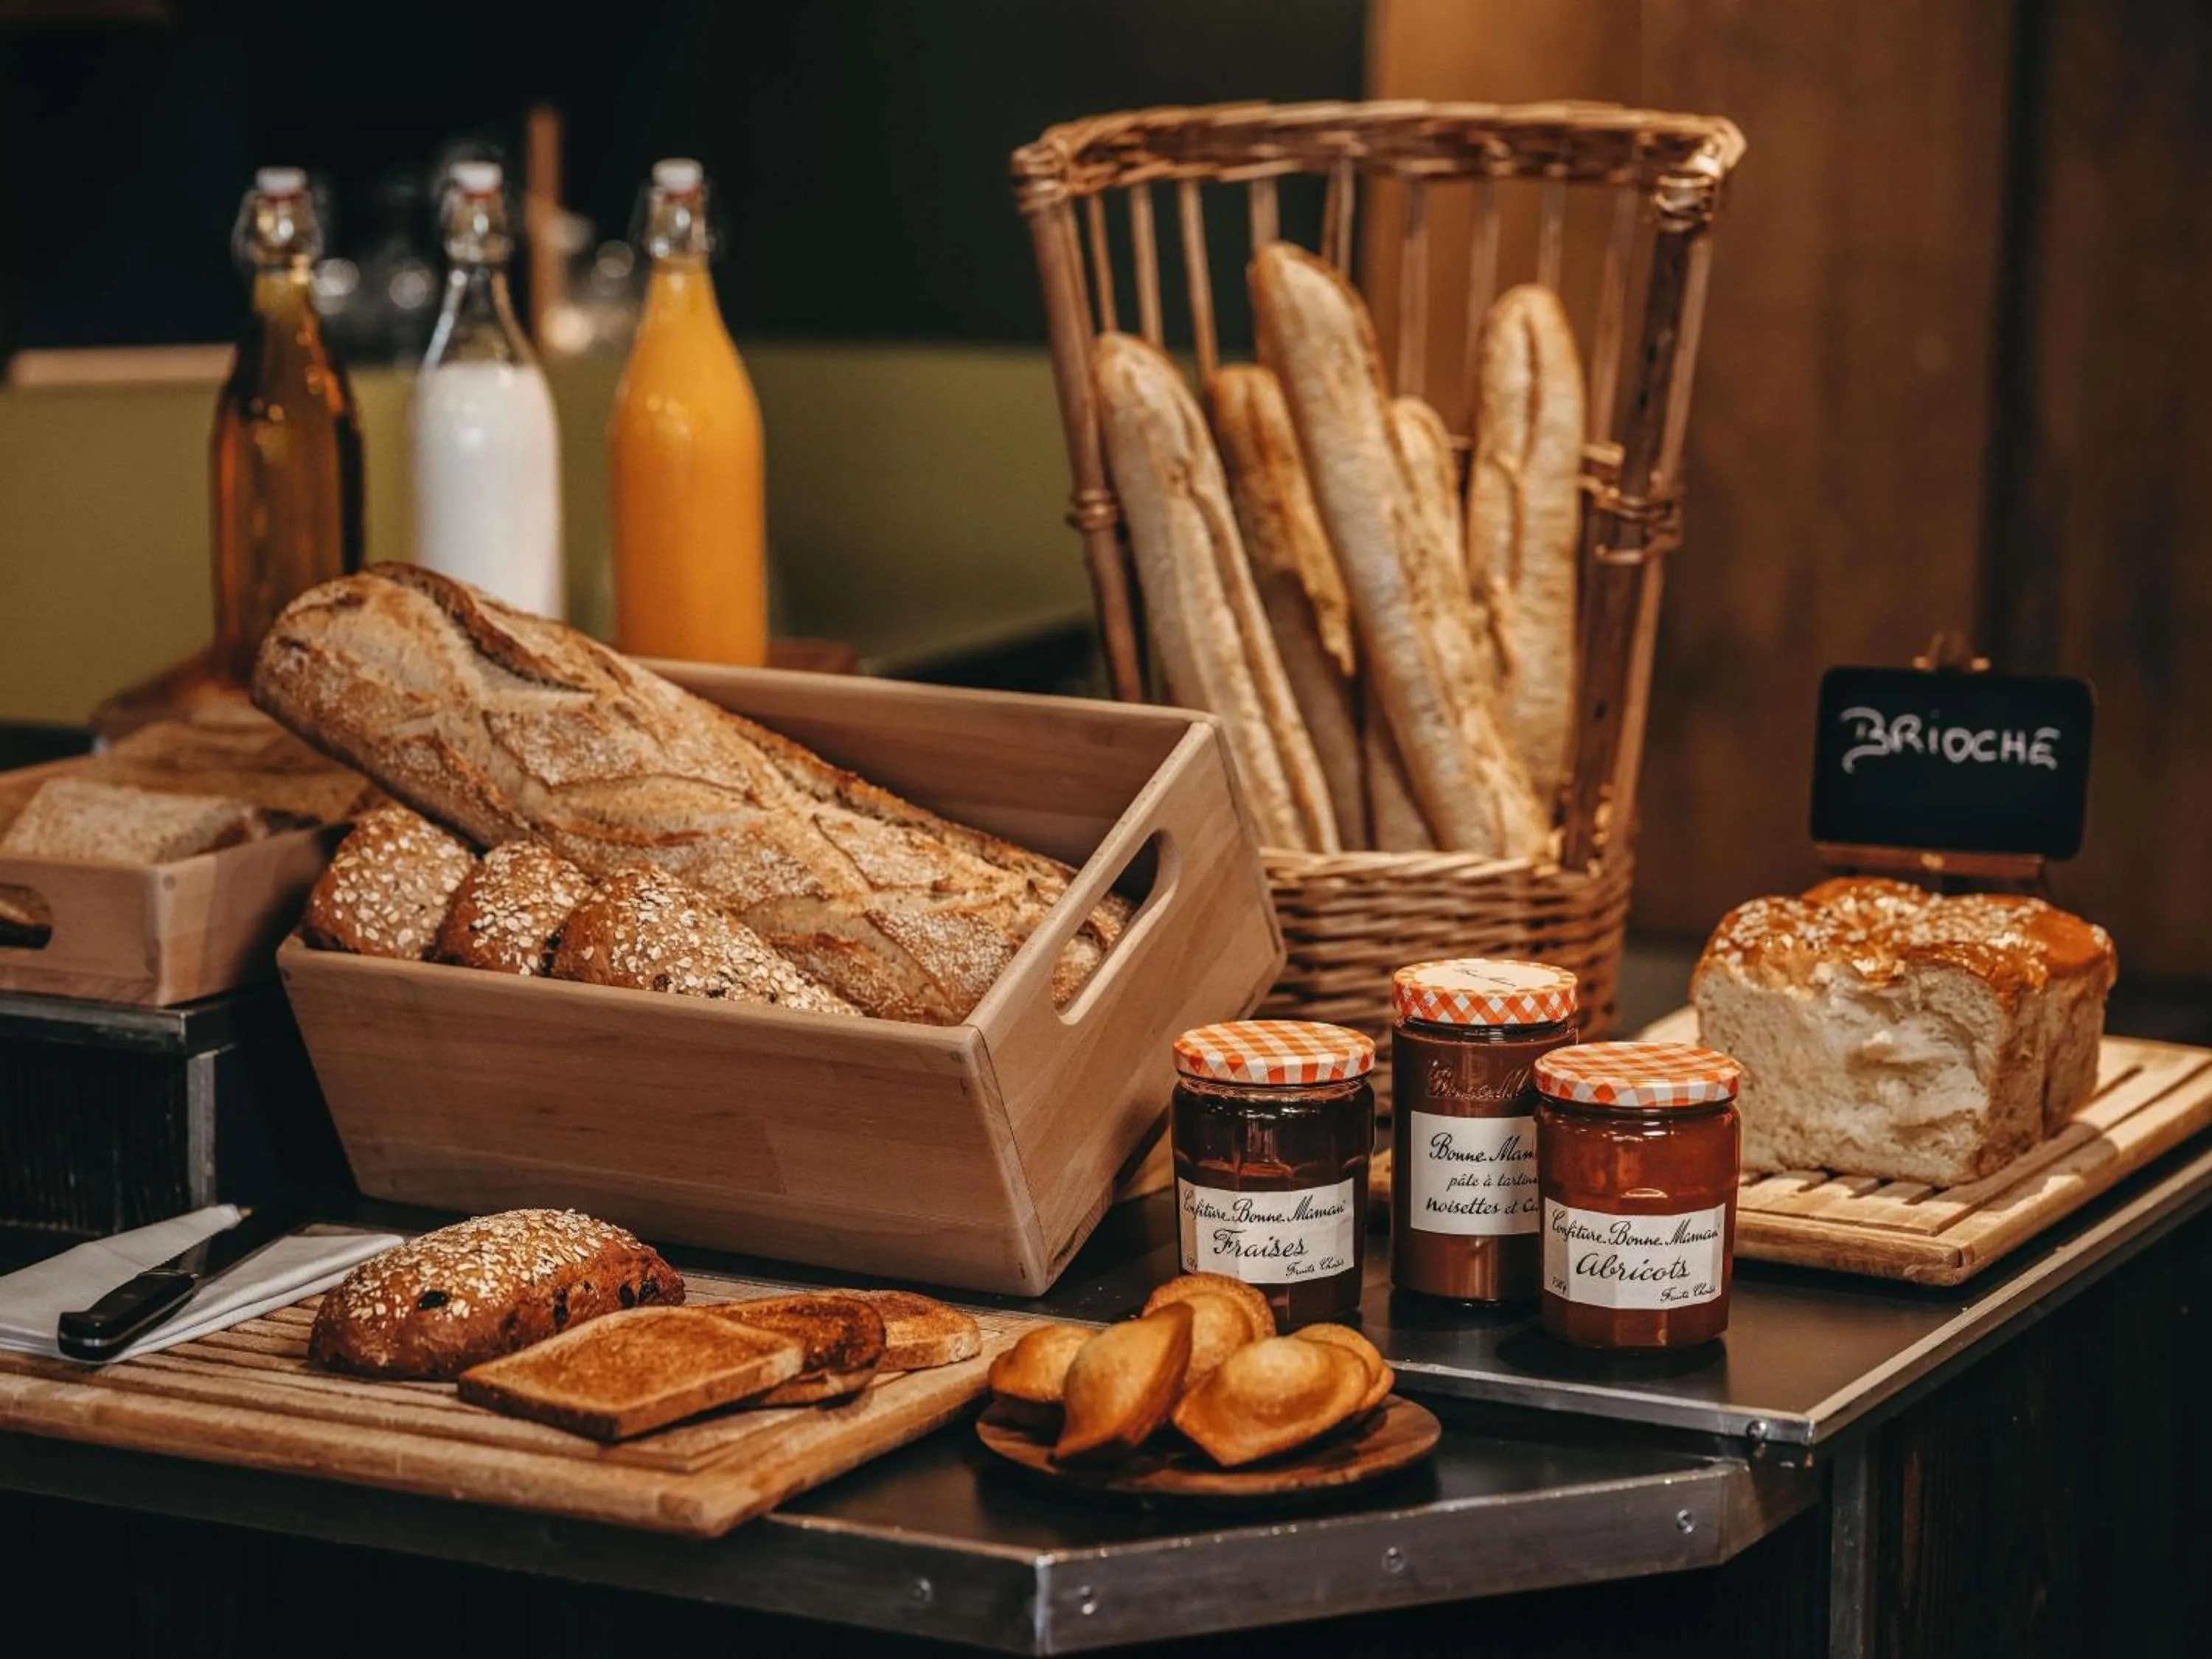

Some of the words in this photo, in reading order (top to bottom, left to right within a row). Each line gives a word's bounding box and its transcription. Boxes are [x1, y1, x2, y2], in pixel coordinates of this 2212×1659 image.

[1429, 1132, 1486, 1163] Bonne
[1489, 1135, 1534, 1163] Mam
[1446, 1173, 1479, 1192] pâte
[1483, 1174, 1492, 1186] à
[1497, 1172, 1538, 1187] tartin
[1232, 1197, 1285, 1222] Bonne
[1287, 1194, 1345, 1222] Maman
[1425, 1197, 1501, 1215] noisettes
[1504, 1199, 1519, 1214] et
[1551, 1210, 1606, 1245] Confiture
[1607, 1220, 1663, 1246] Bonne
[1664, 1217, 1719, 1246] Maman
[1213, 1228, 1309, 1258] Fraises
[1575, 1253, 1691, 1281] Abricots
